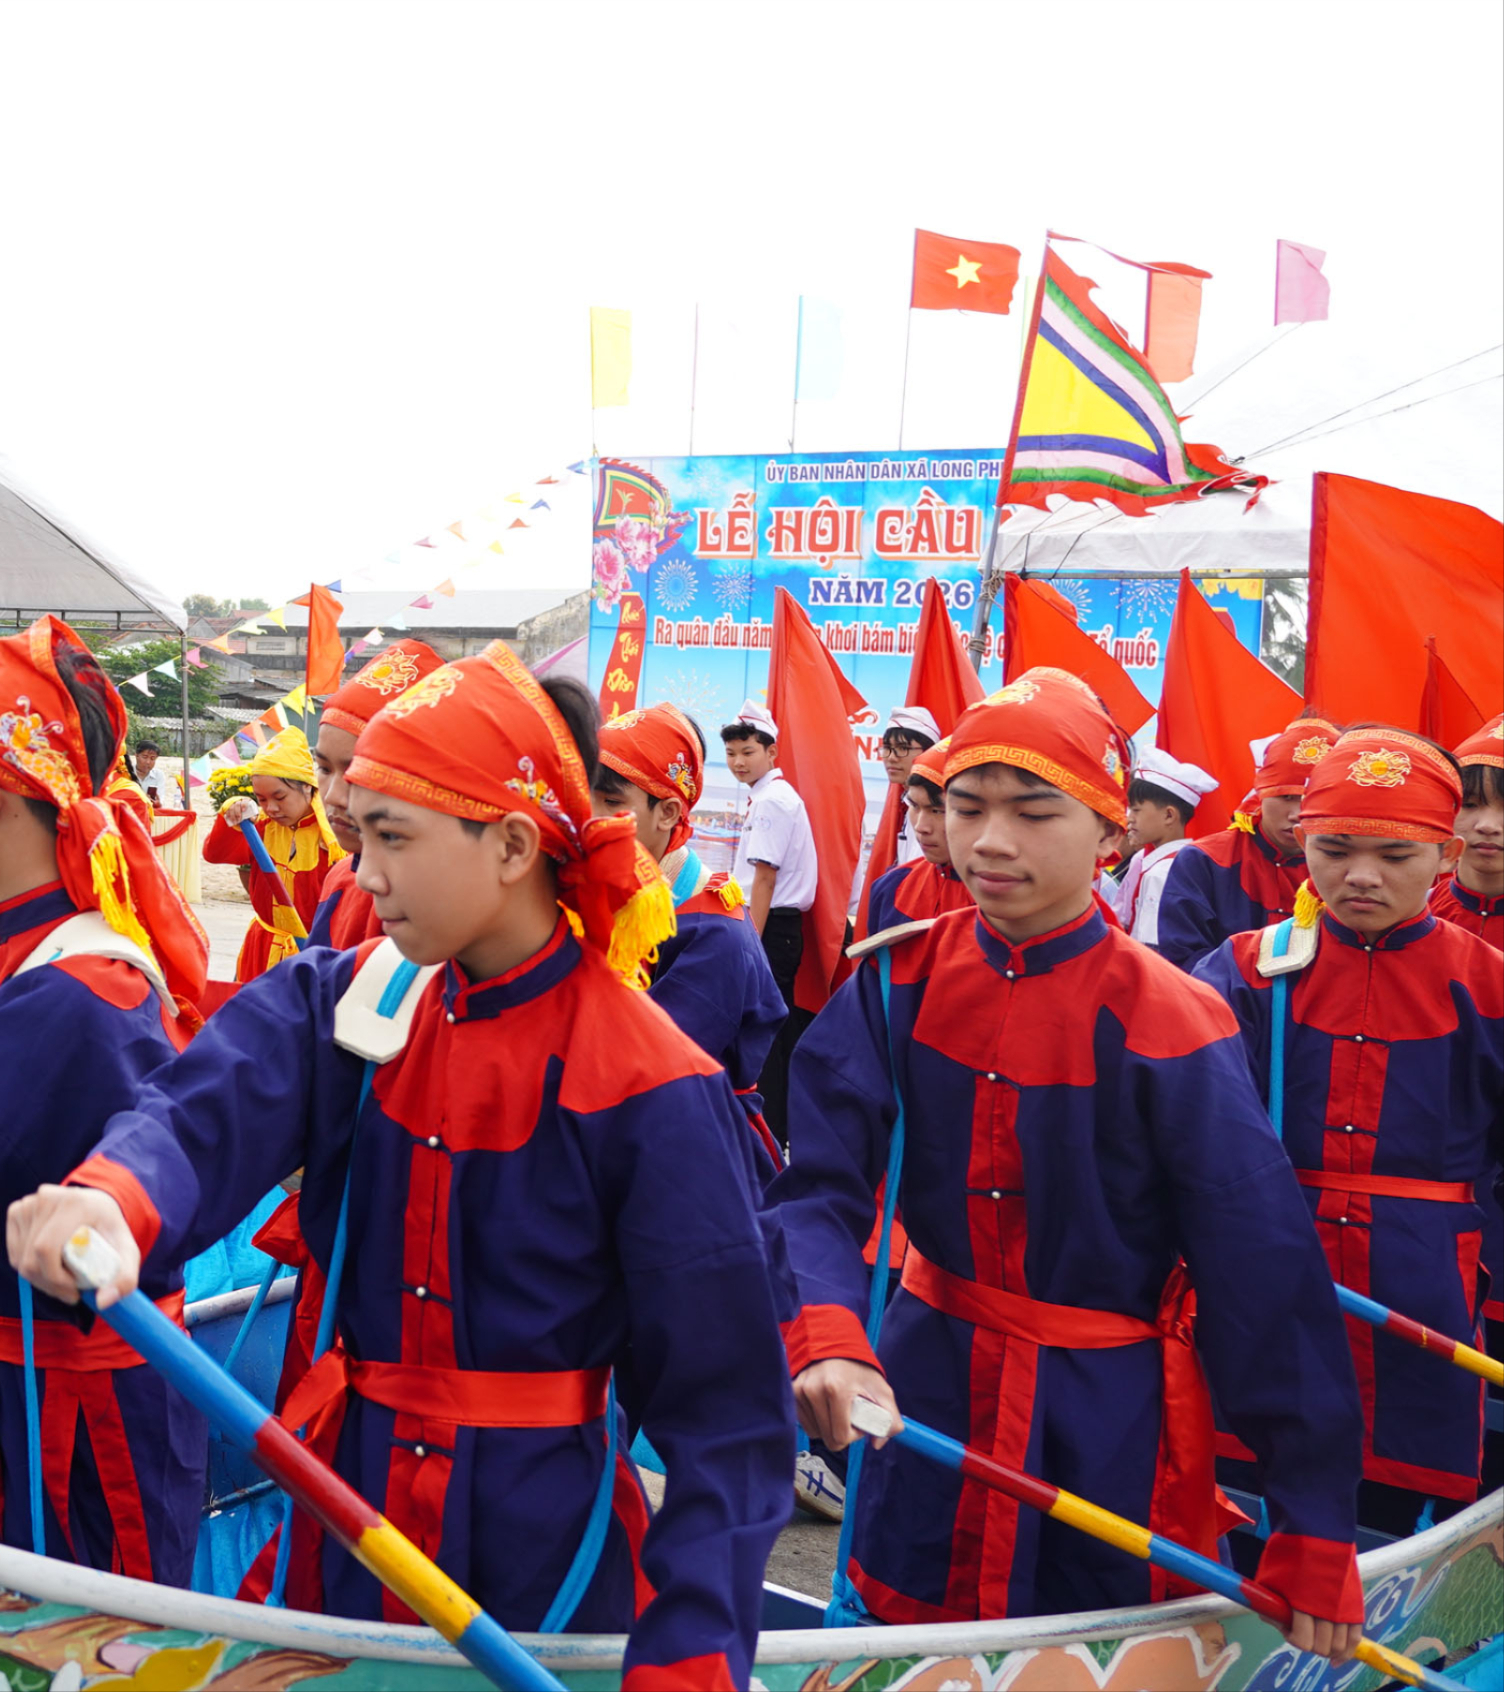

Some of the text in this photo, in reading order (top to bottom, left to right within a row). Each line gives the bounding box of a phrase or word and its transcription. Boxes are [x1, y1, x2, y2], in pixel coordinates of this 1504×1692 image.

[767, 460, 1003, 481] ỦY BAN NHÂN DÂN XÃ LONG PH
[697, 489, 975, 563] LỄ HỘI CẦU
[812, 575, 884, 604] NĂM
[655, 617, 672, 645] Ra
[676, 618, 709, 648] quân
[713, 614, 739, 647] đầu
[742, 619, 773, 648] năm
[861, 623, 894, 653] bám
